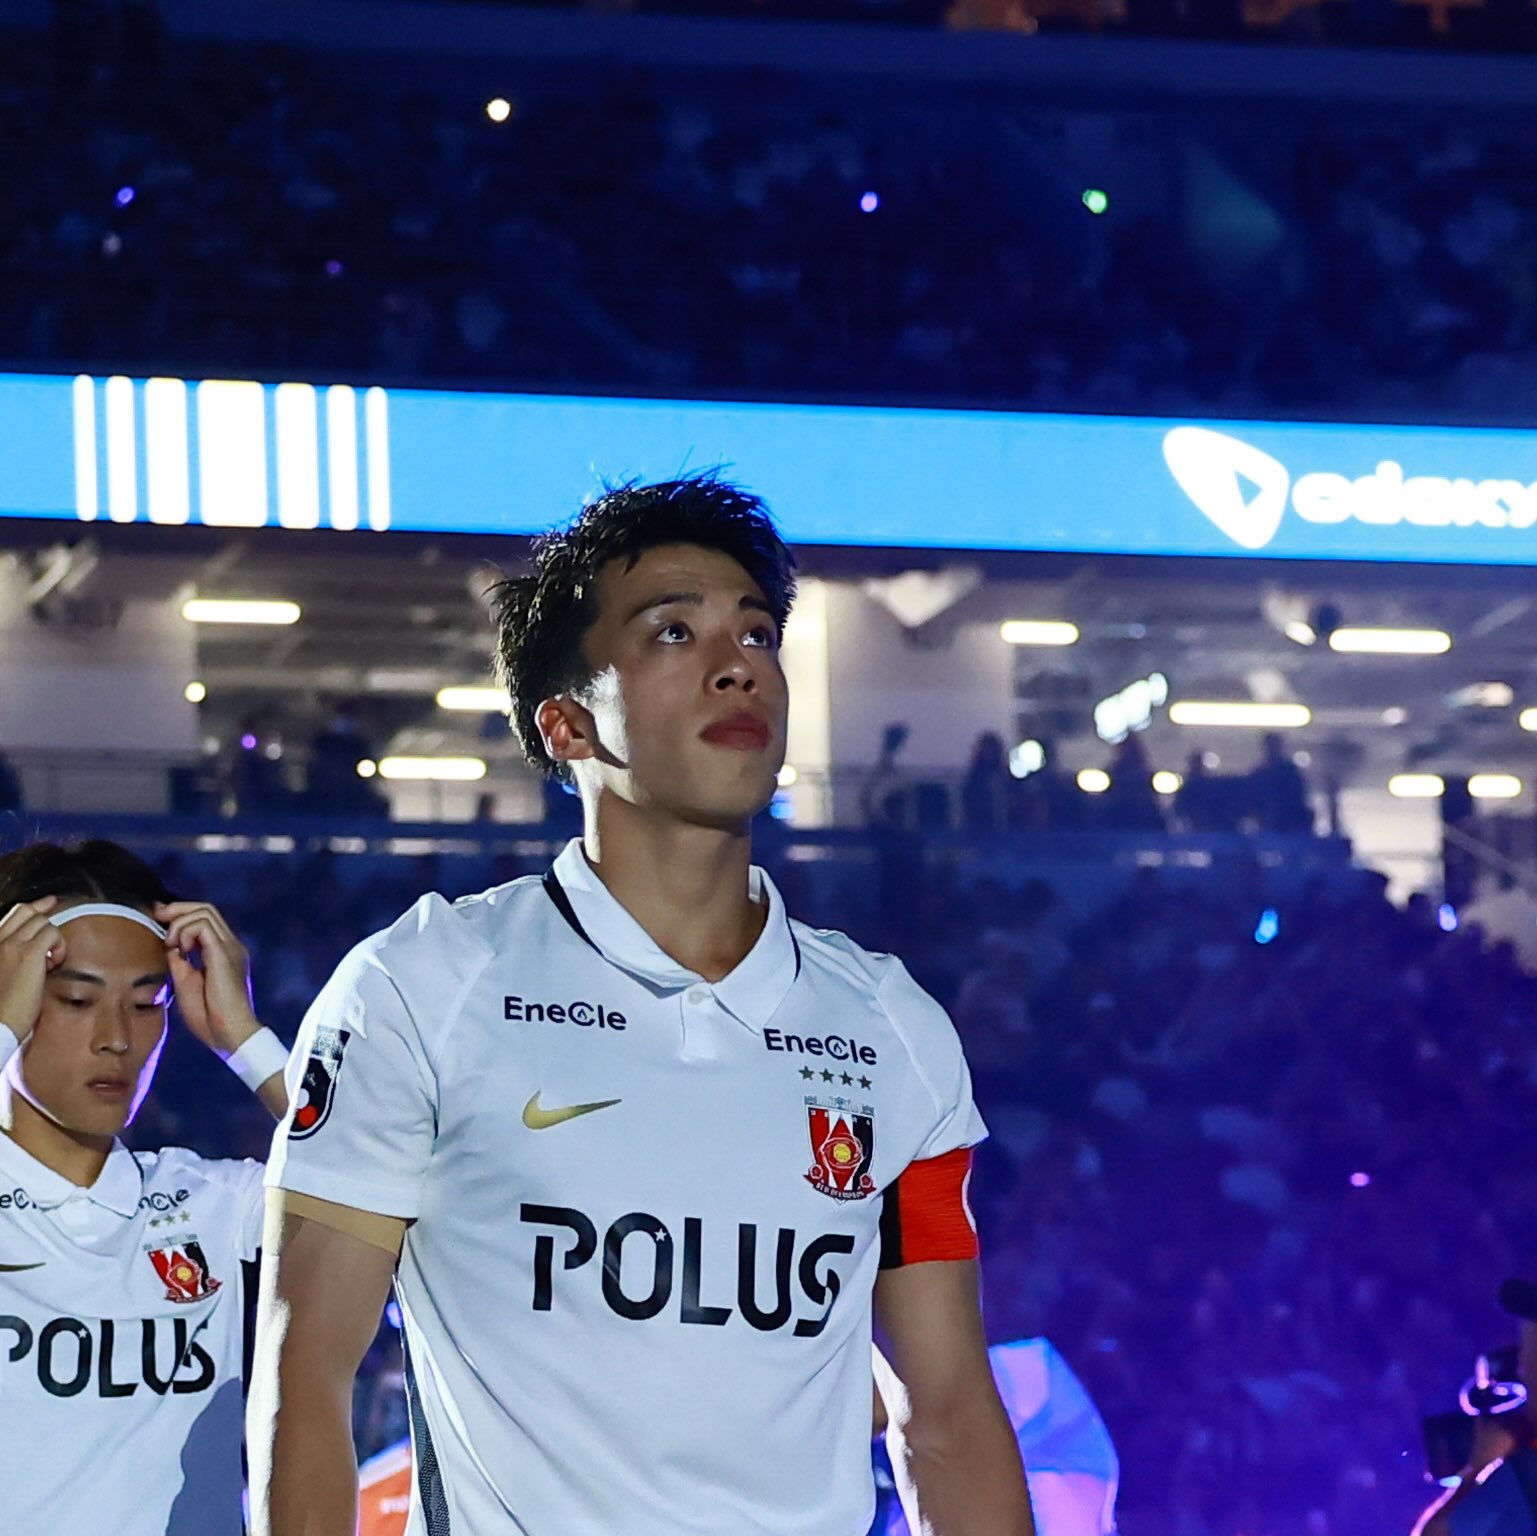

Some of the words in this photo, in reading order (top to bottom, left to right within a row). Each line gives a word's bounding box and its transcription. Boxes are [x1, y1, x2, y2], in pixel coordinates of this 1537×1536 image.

[504, 995, 627, 1031] EneCle
[763, 1027, 877, 1066] EneCle
[519, 1202, 856, 1338] POLUS
